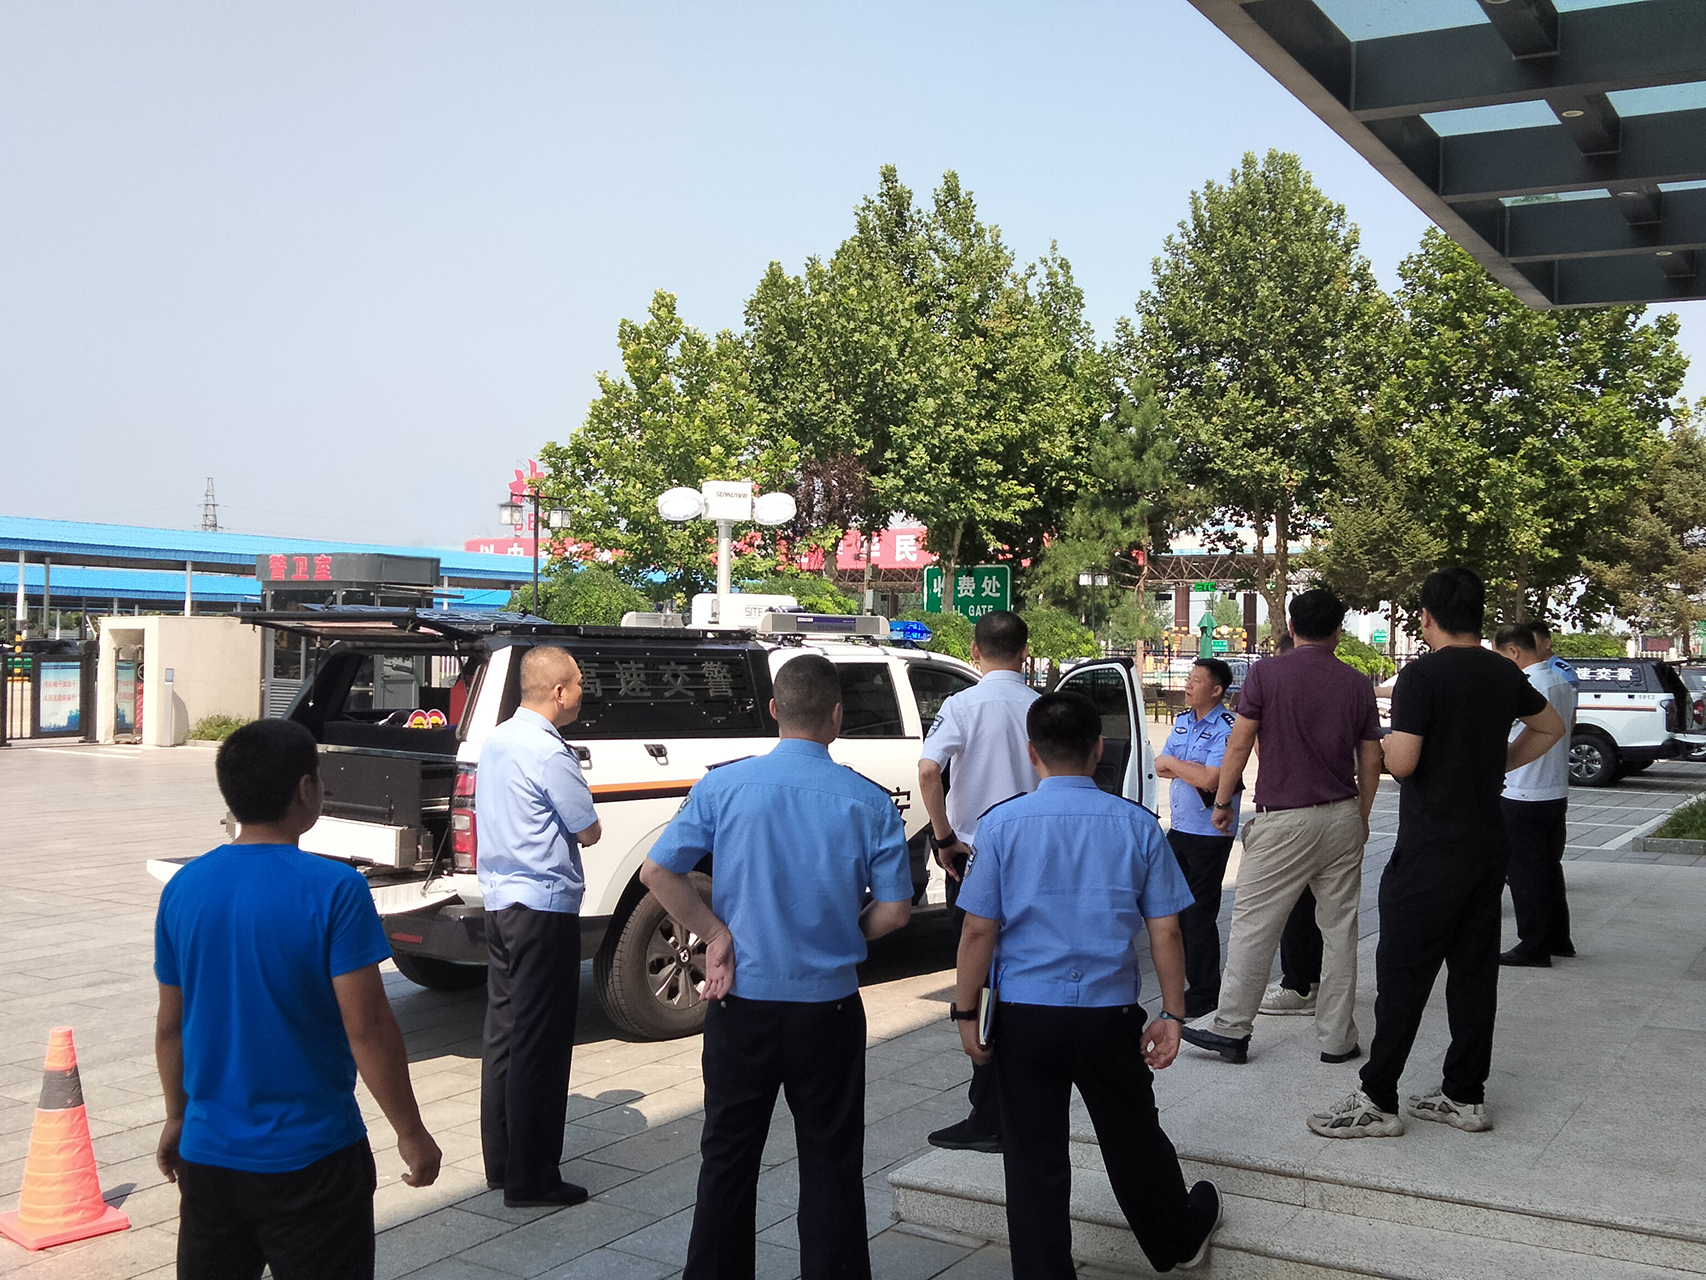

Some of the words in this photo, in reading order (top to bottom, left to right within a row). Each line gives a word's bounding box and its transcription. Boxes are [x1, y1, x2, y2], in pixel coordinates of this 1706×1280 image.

[269, 554, 332, 580] 警卫室
[1195, 582, 1216, 592] ETC
[578, 659, 733, 697] 高速交警
